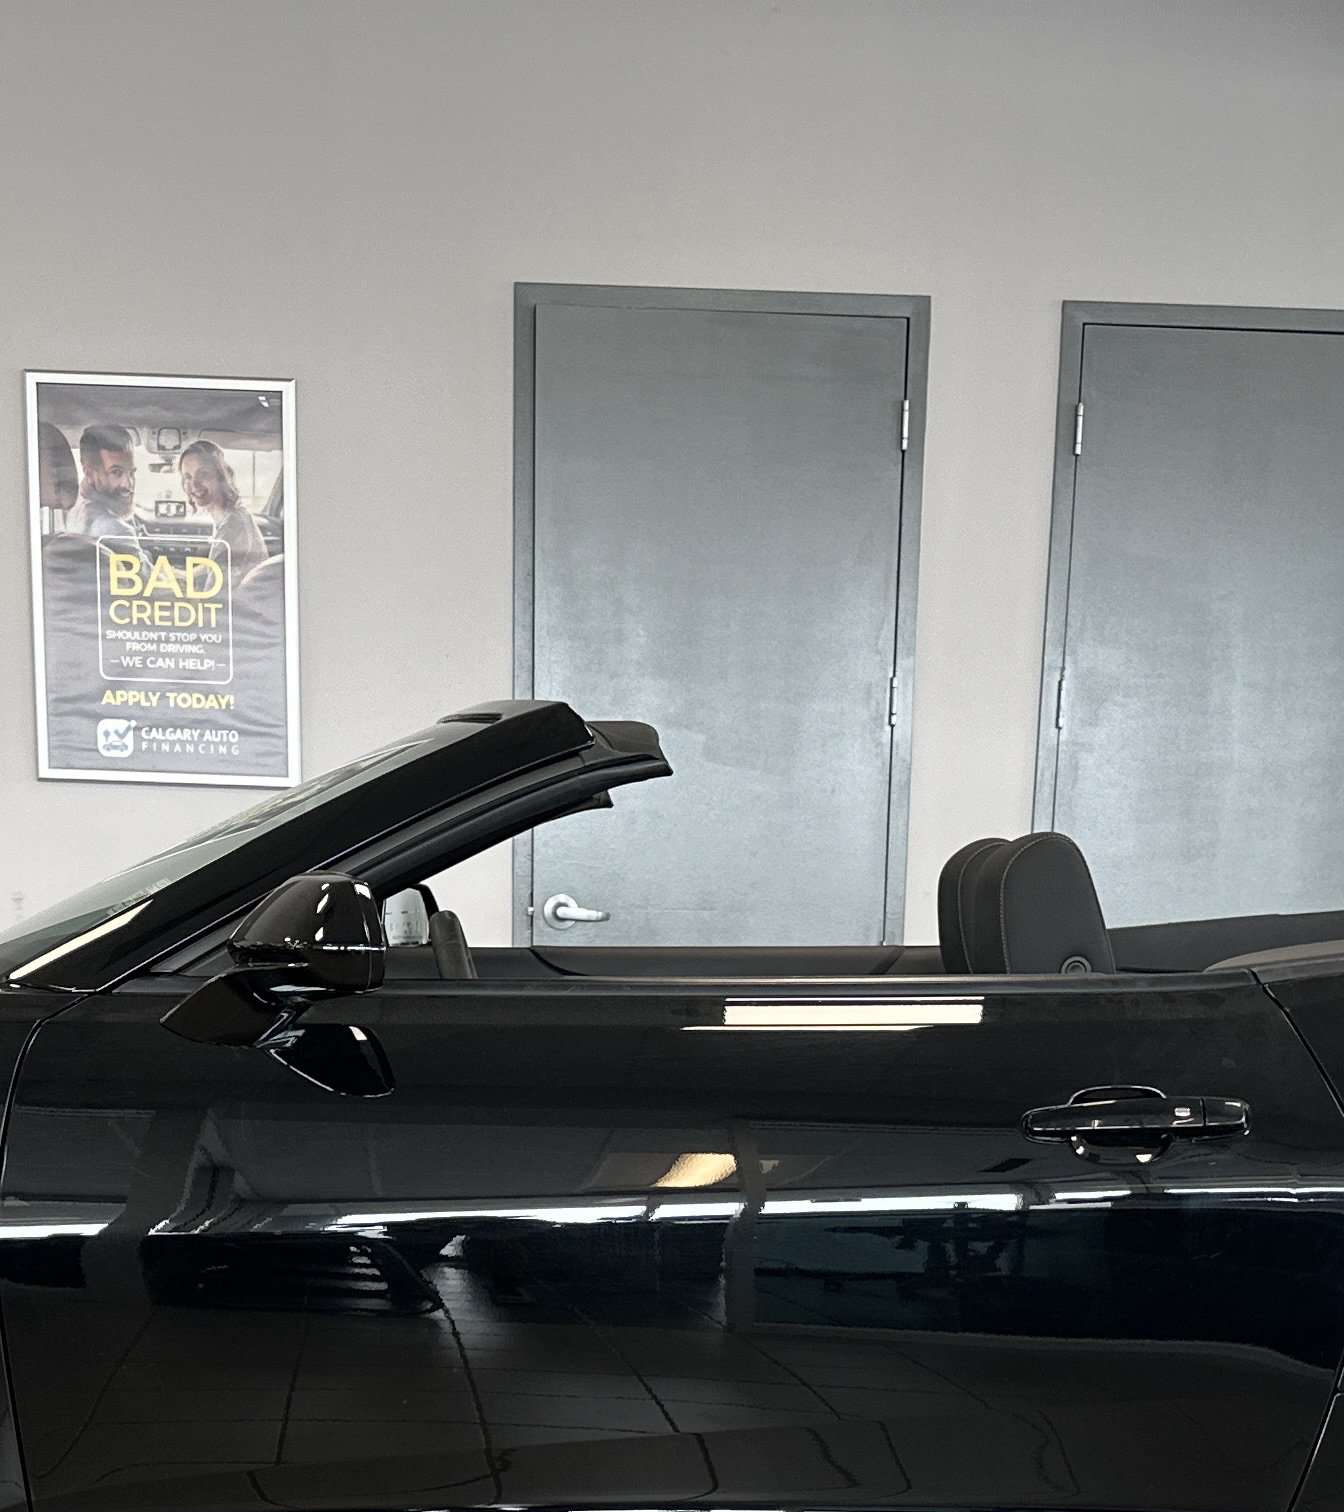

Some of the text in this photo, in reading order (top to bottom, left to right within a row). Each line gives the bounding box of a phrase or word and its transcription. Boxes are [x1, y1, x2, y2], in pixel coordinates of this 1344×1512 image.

[109, 553, 224, 599] BAD
[109, 600, 223, 628] CREDIT
[105, 629, 222, 644] SHOULDN'T STOP YOU
[125, 642, 157, 652] FROM
[120, 656, 215, 671] WE CAN HELP!
[101, 689, 235, 710] APPLY TODAY!
[141, 726, 239, 743] CALGARY AUTO
[141, 741, 240, 755] FINANCING
